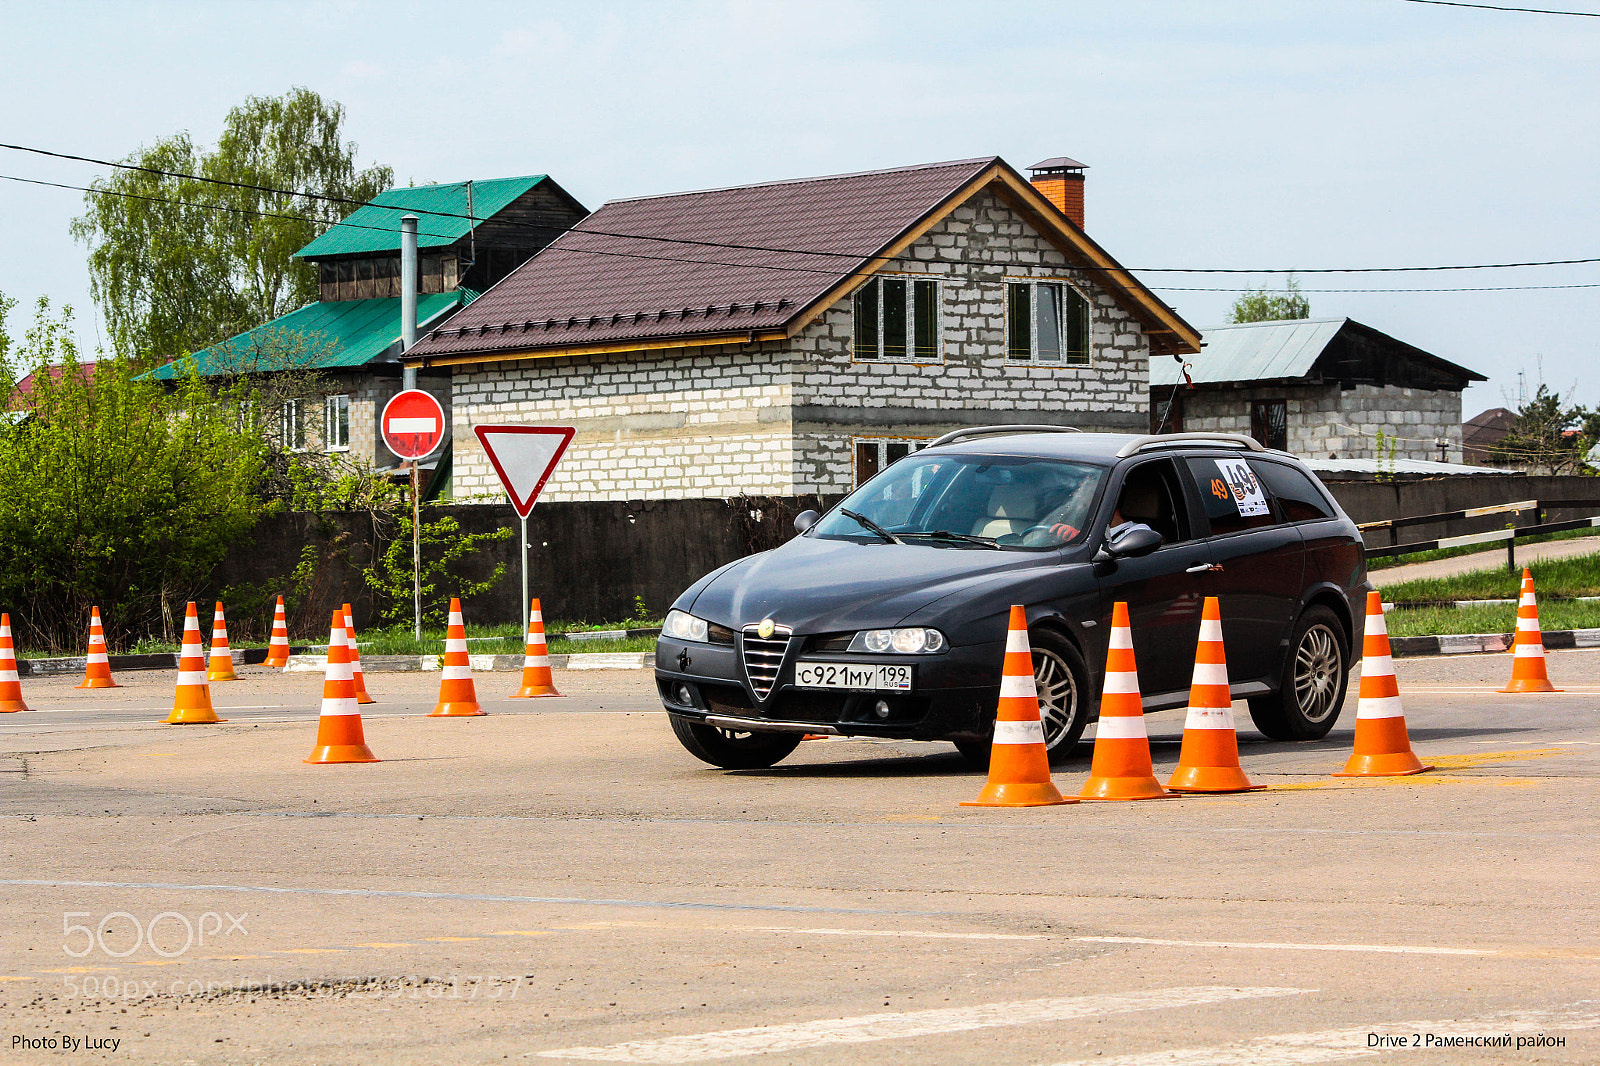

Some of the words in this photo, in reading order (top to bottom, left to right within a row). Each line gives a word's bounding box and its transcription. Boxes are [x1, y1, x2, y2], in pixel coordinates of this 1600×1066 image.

[1211, 478, 1229, 500] 49
[1226, 464, 1256, 496] 49
[879, 667, 906, 682] 199
